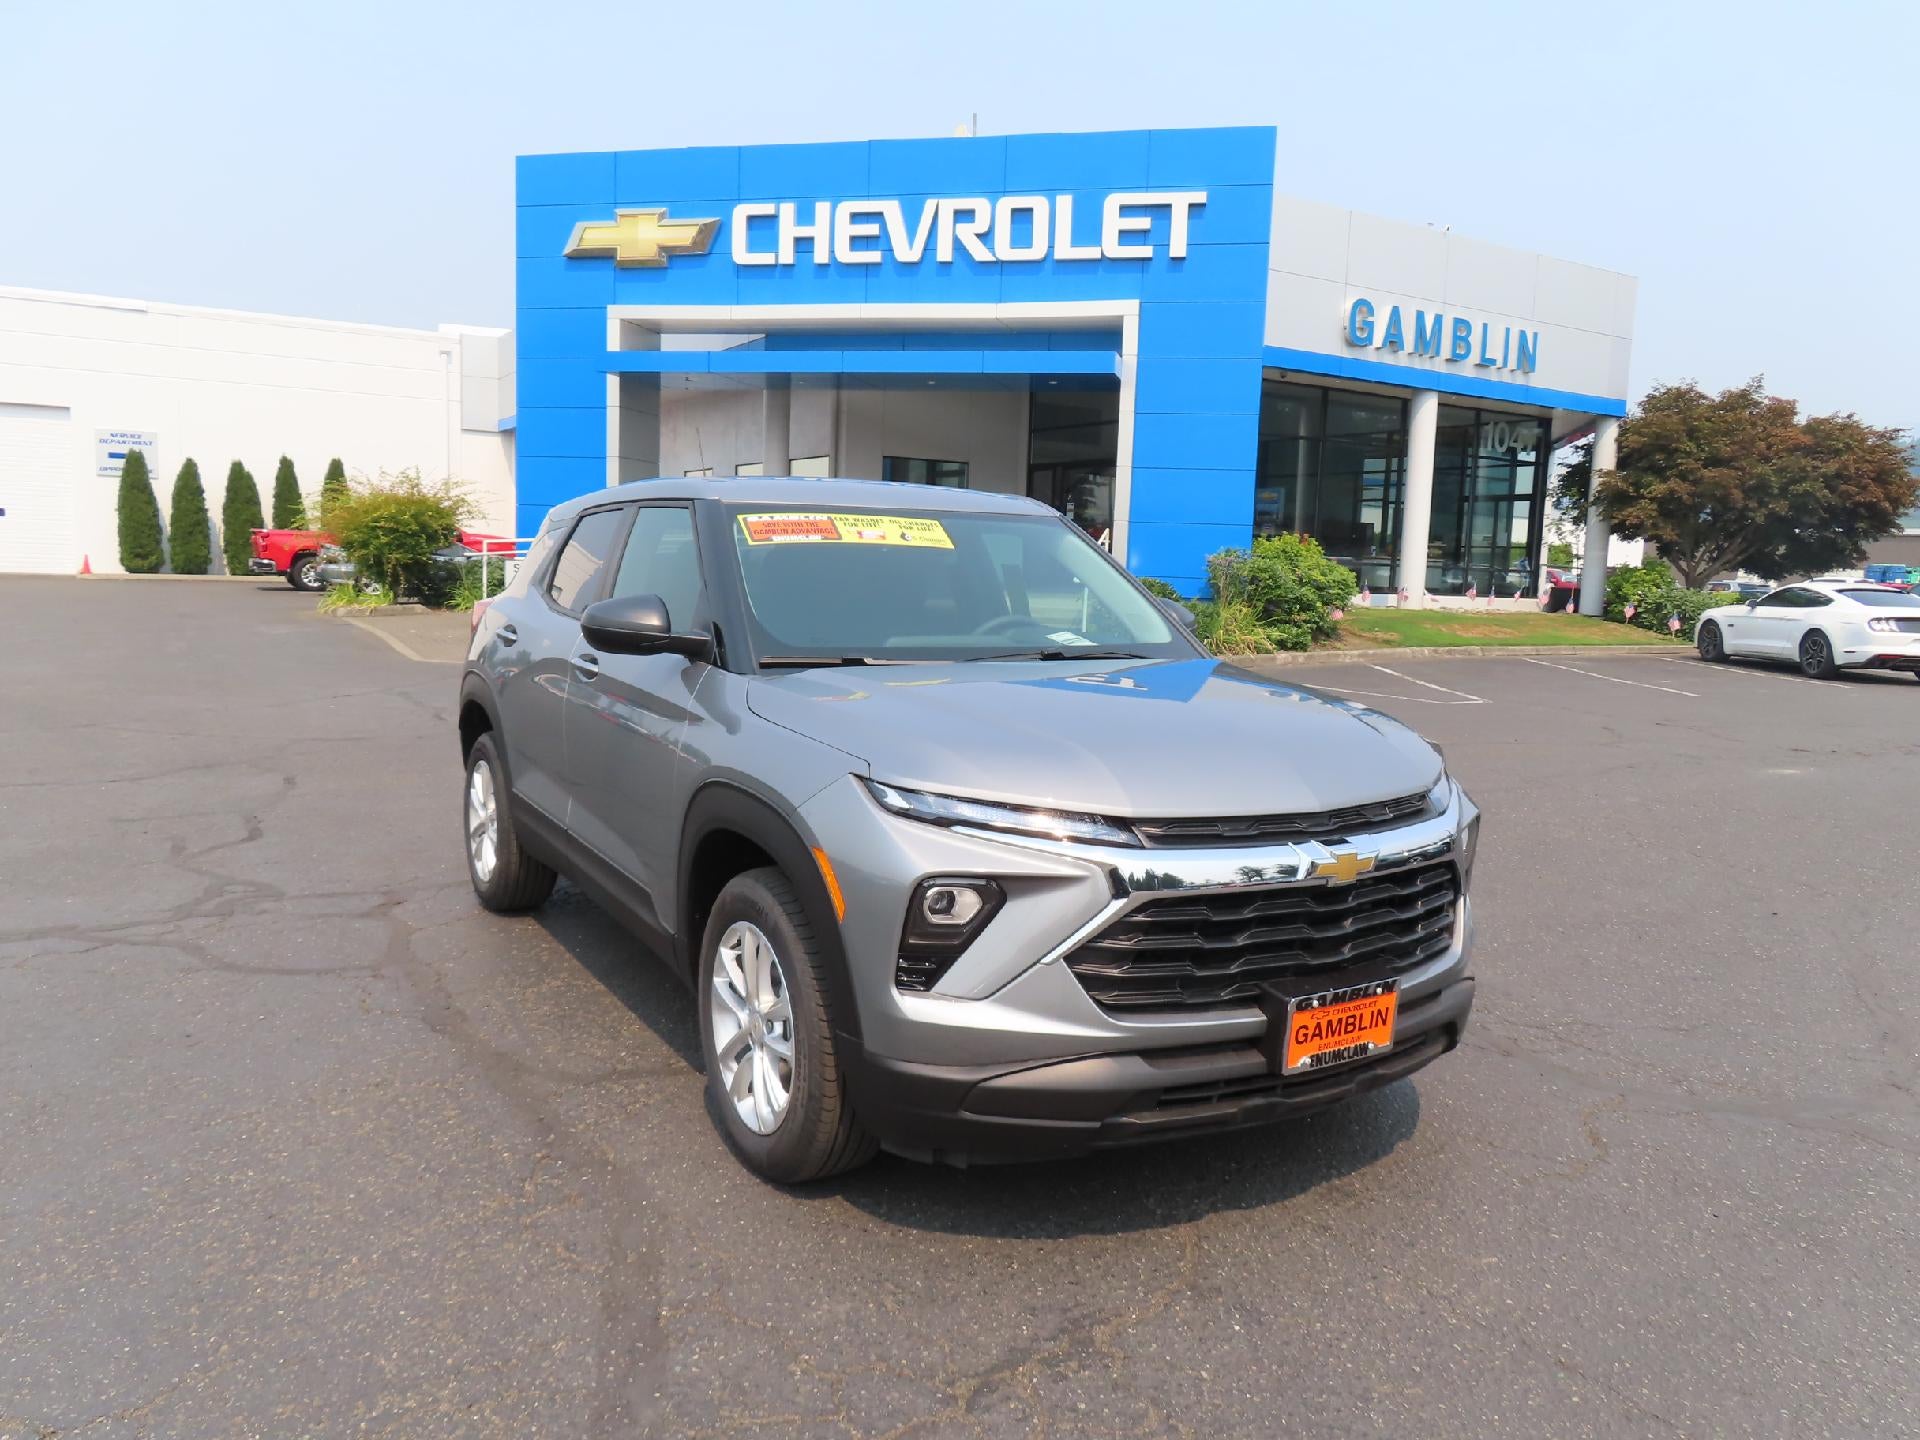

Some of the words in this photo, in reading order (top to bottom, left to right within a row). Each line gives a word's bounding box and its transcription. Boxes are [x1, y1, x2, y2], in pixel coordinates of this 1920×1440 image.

[731, 191, 1207, 265] CHEVROLET
[1348, 297, 1538, 373] GAMBLIN
[1332, 1000, 1378, 1016] CHEVROLET
[1295, 1007, 1389, 1045] GAMBLIN
[1309, 1041, 1369, 1069] ENUMCLAW
[1318, 1035, 1362, 1051] ENUMCLAW
